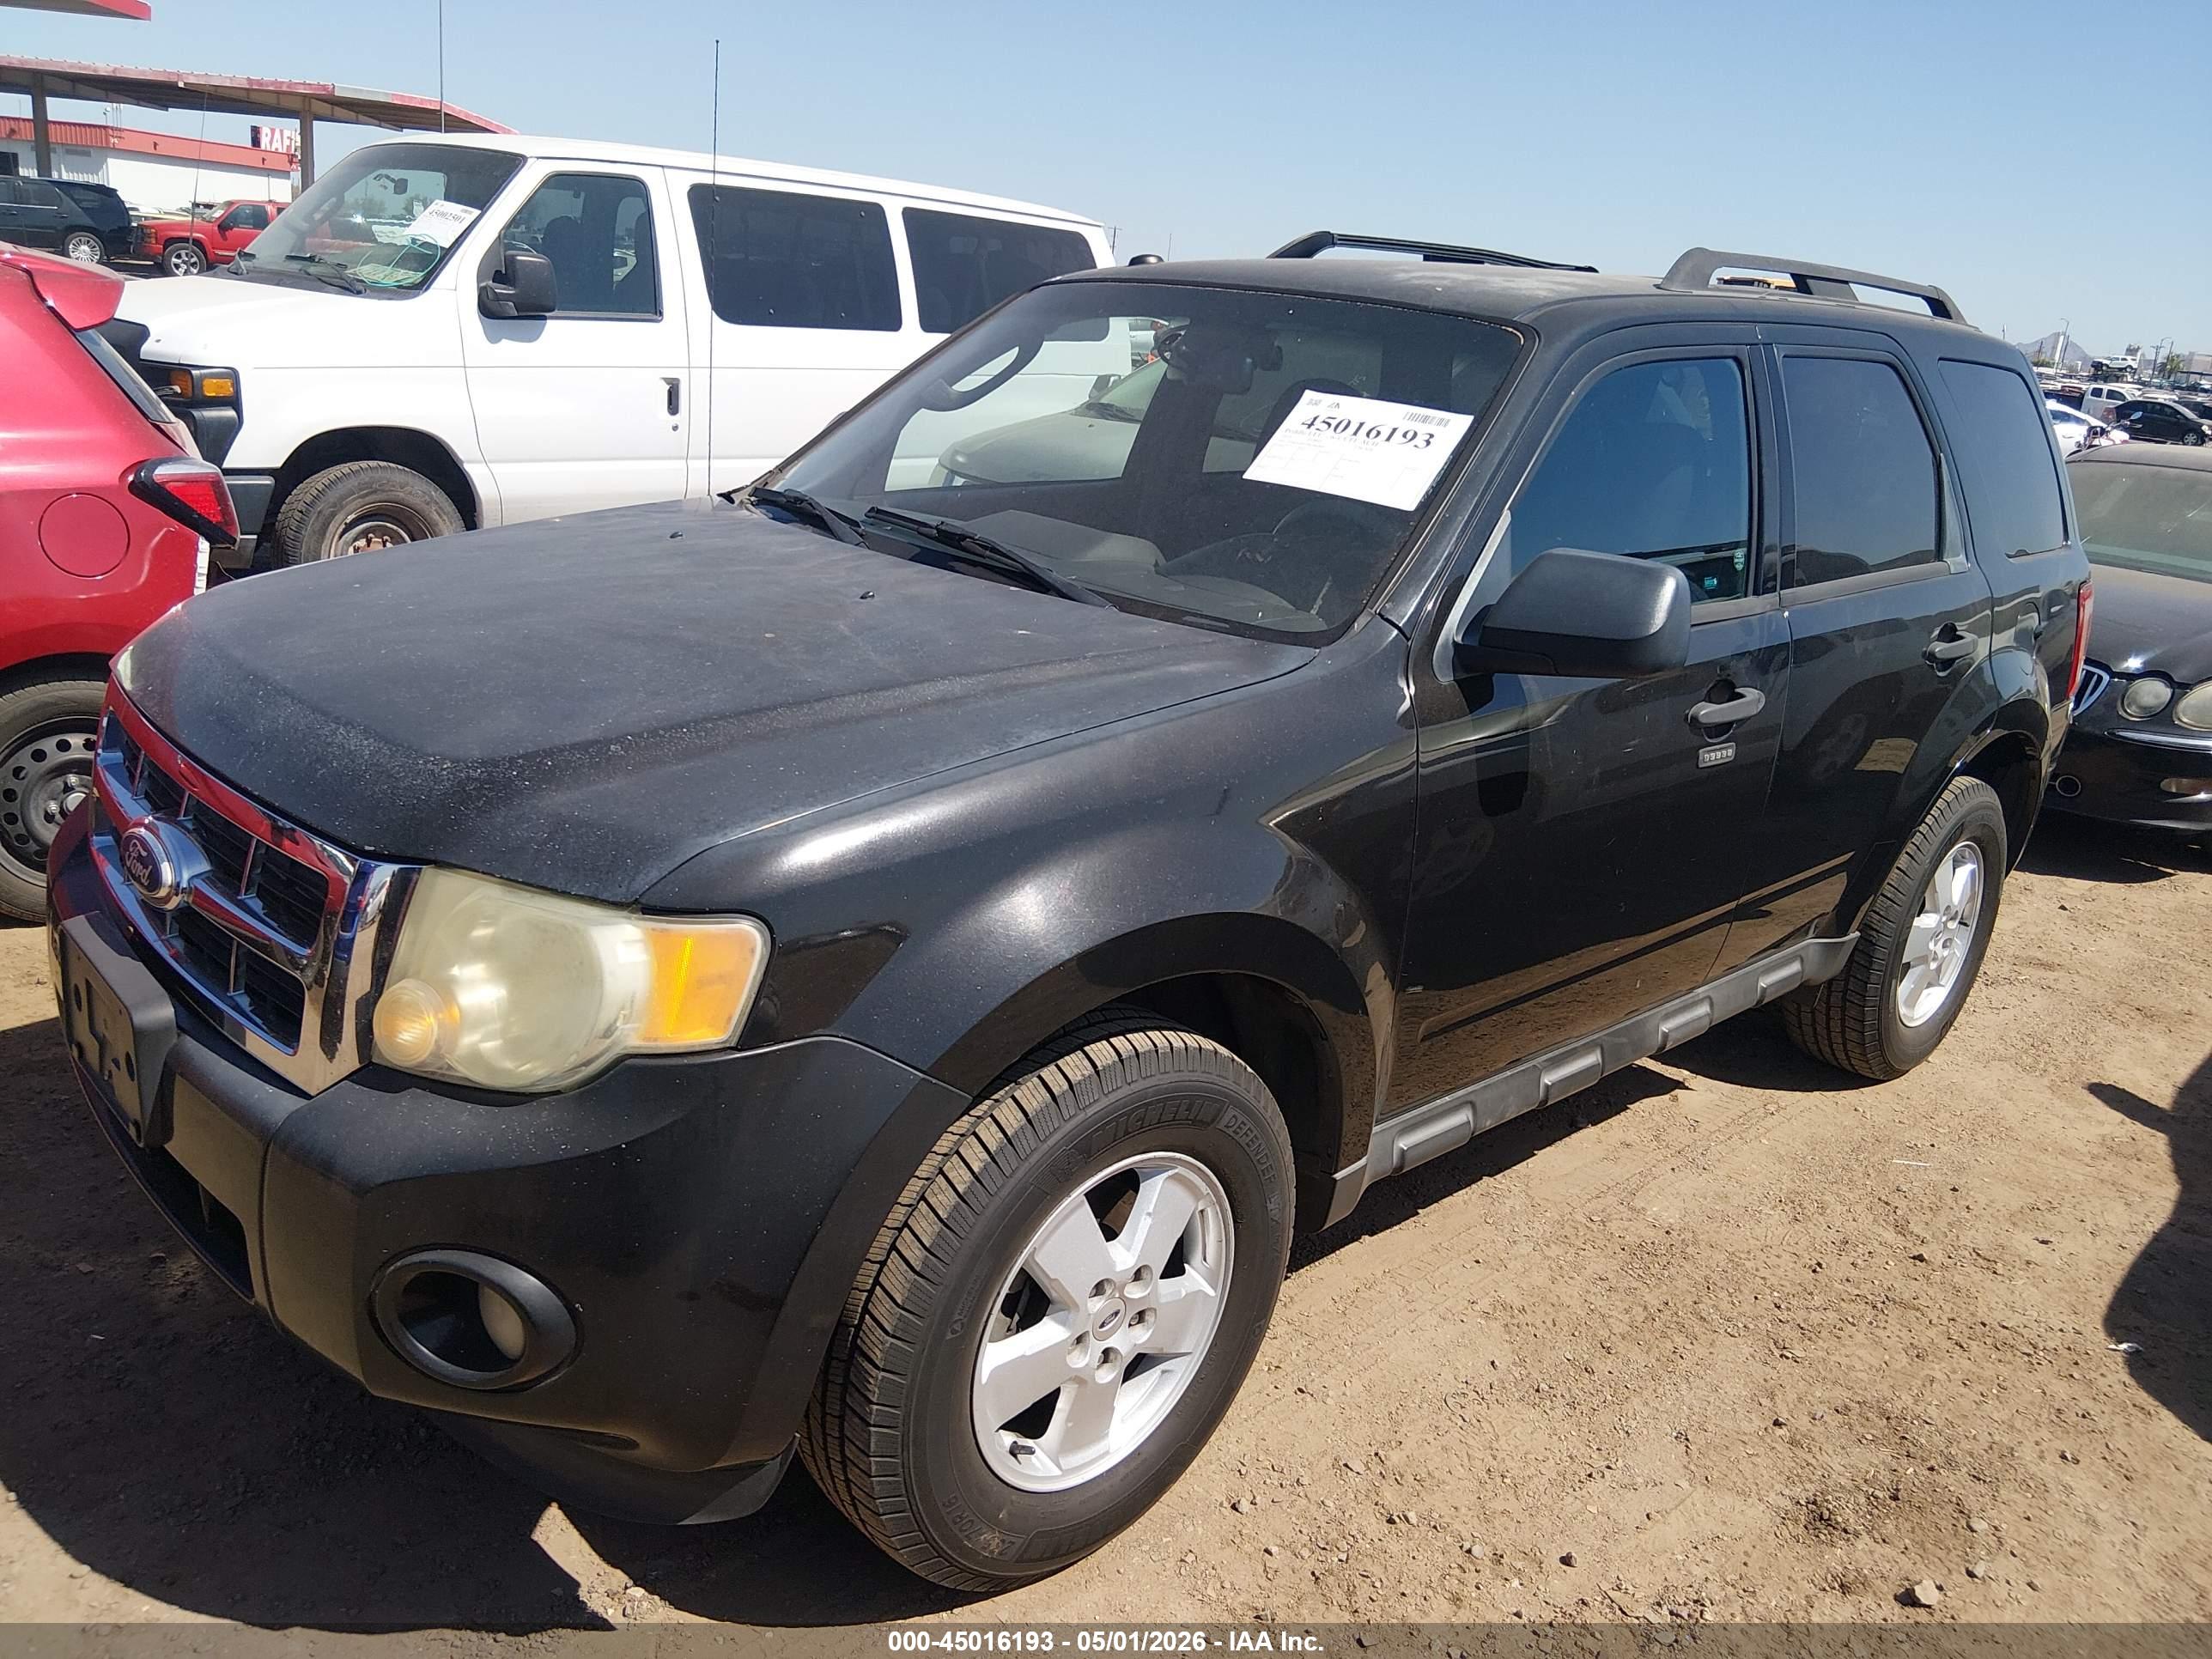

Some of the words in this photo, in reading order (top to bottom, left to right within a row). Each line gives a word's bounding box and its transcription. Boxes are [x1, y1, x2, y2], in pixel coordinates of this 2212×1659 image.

[1300, 414, 1436, 450] 45016193
[124, 838, 153, 886] Ford
[1089, 1099, 1223, 1157] MICHELIN
